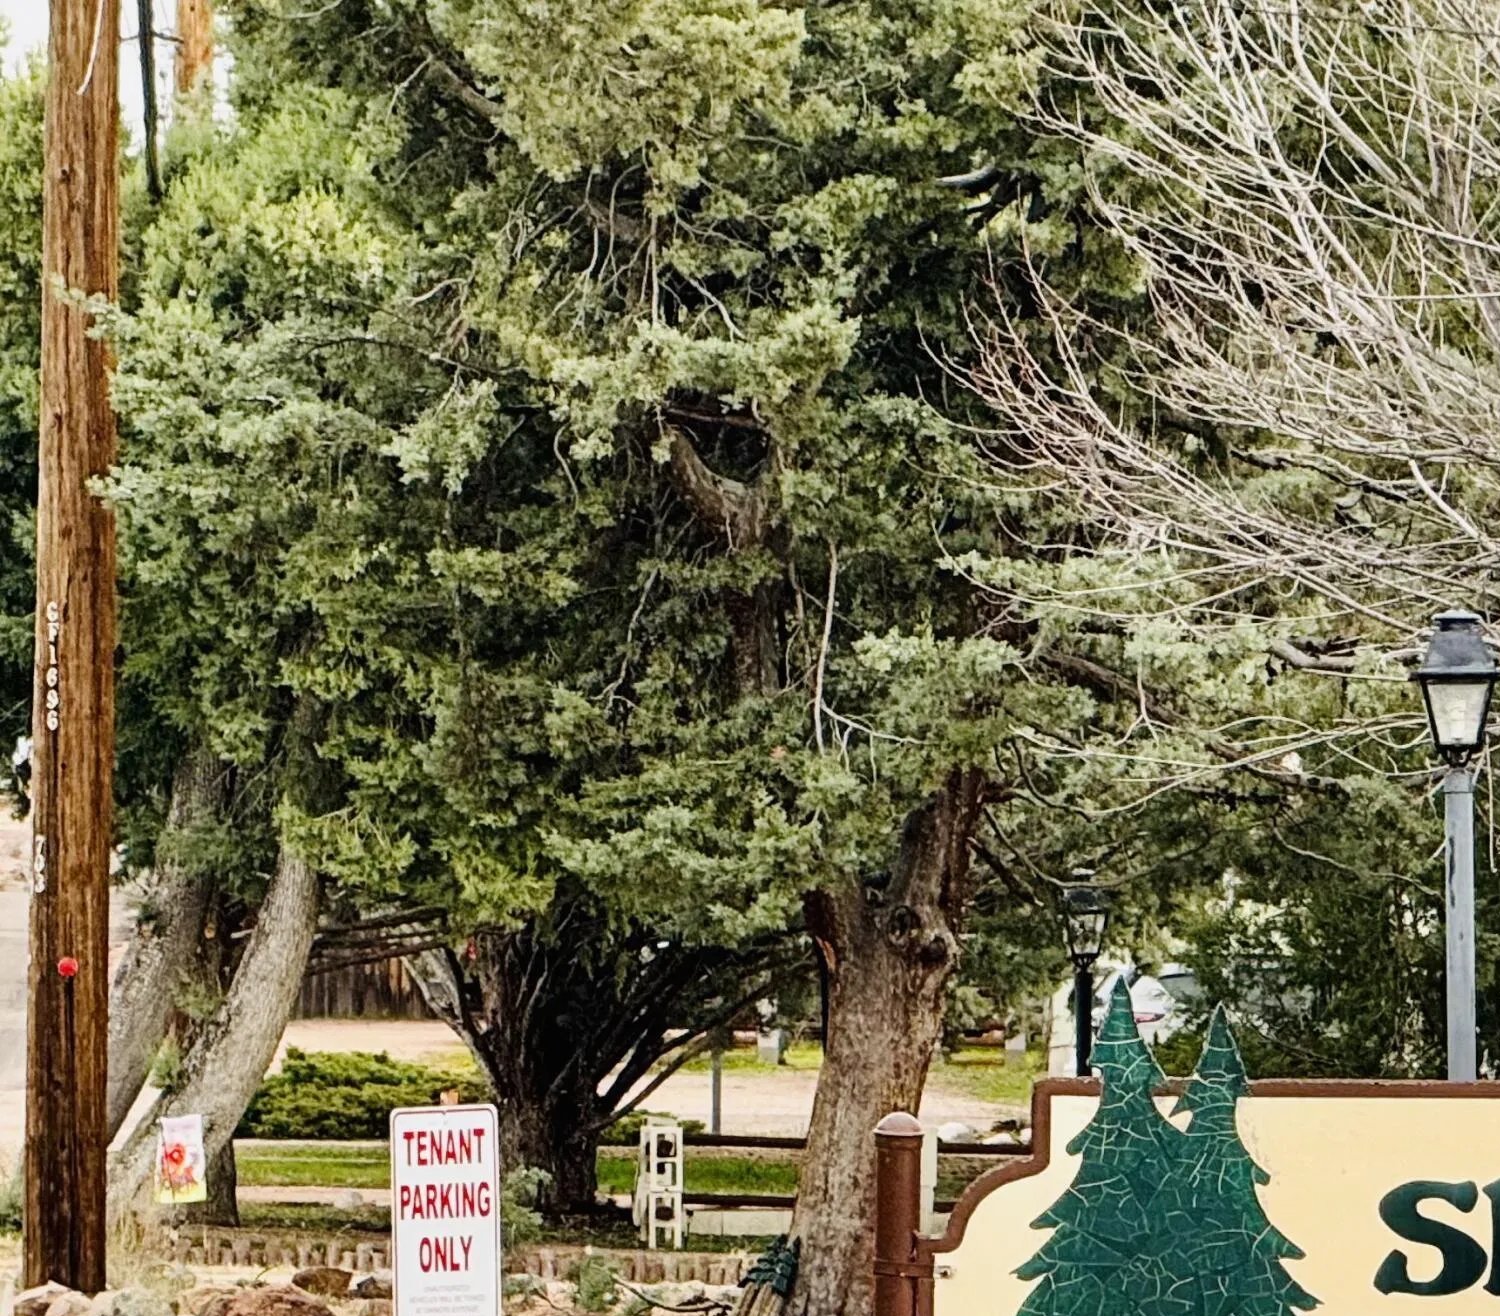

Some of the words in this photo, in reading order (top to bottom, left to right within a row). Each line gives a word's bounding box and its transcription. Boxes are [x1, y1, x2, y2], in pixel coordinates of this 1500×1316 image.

[403, 1128, 485, 1167] TENANT
[400, 1182, 491, 1221] PARKING
[419, 1235, 473, 1273] ONLY
